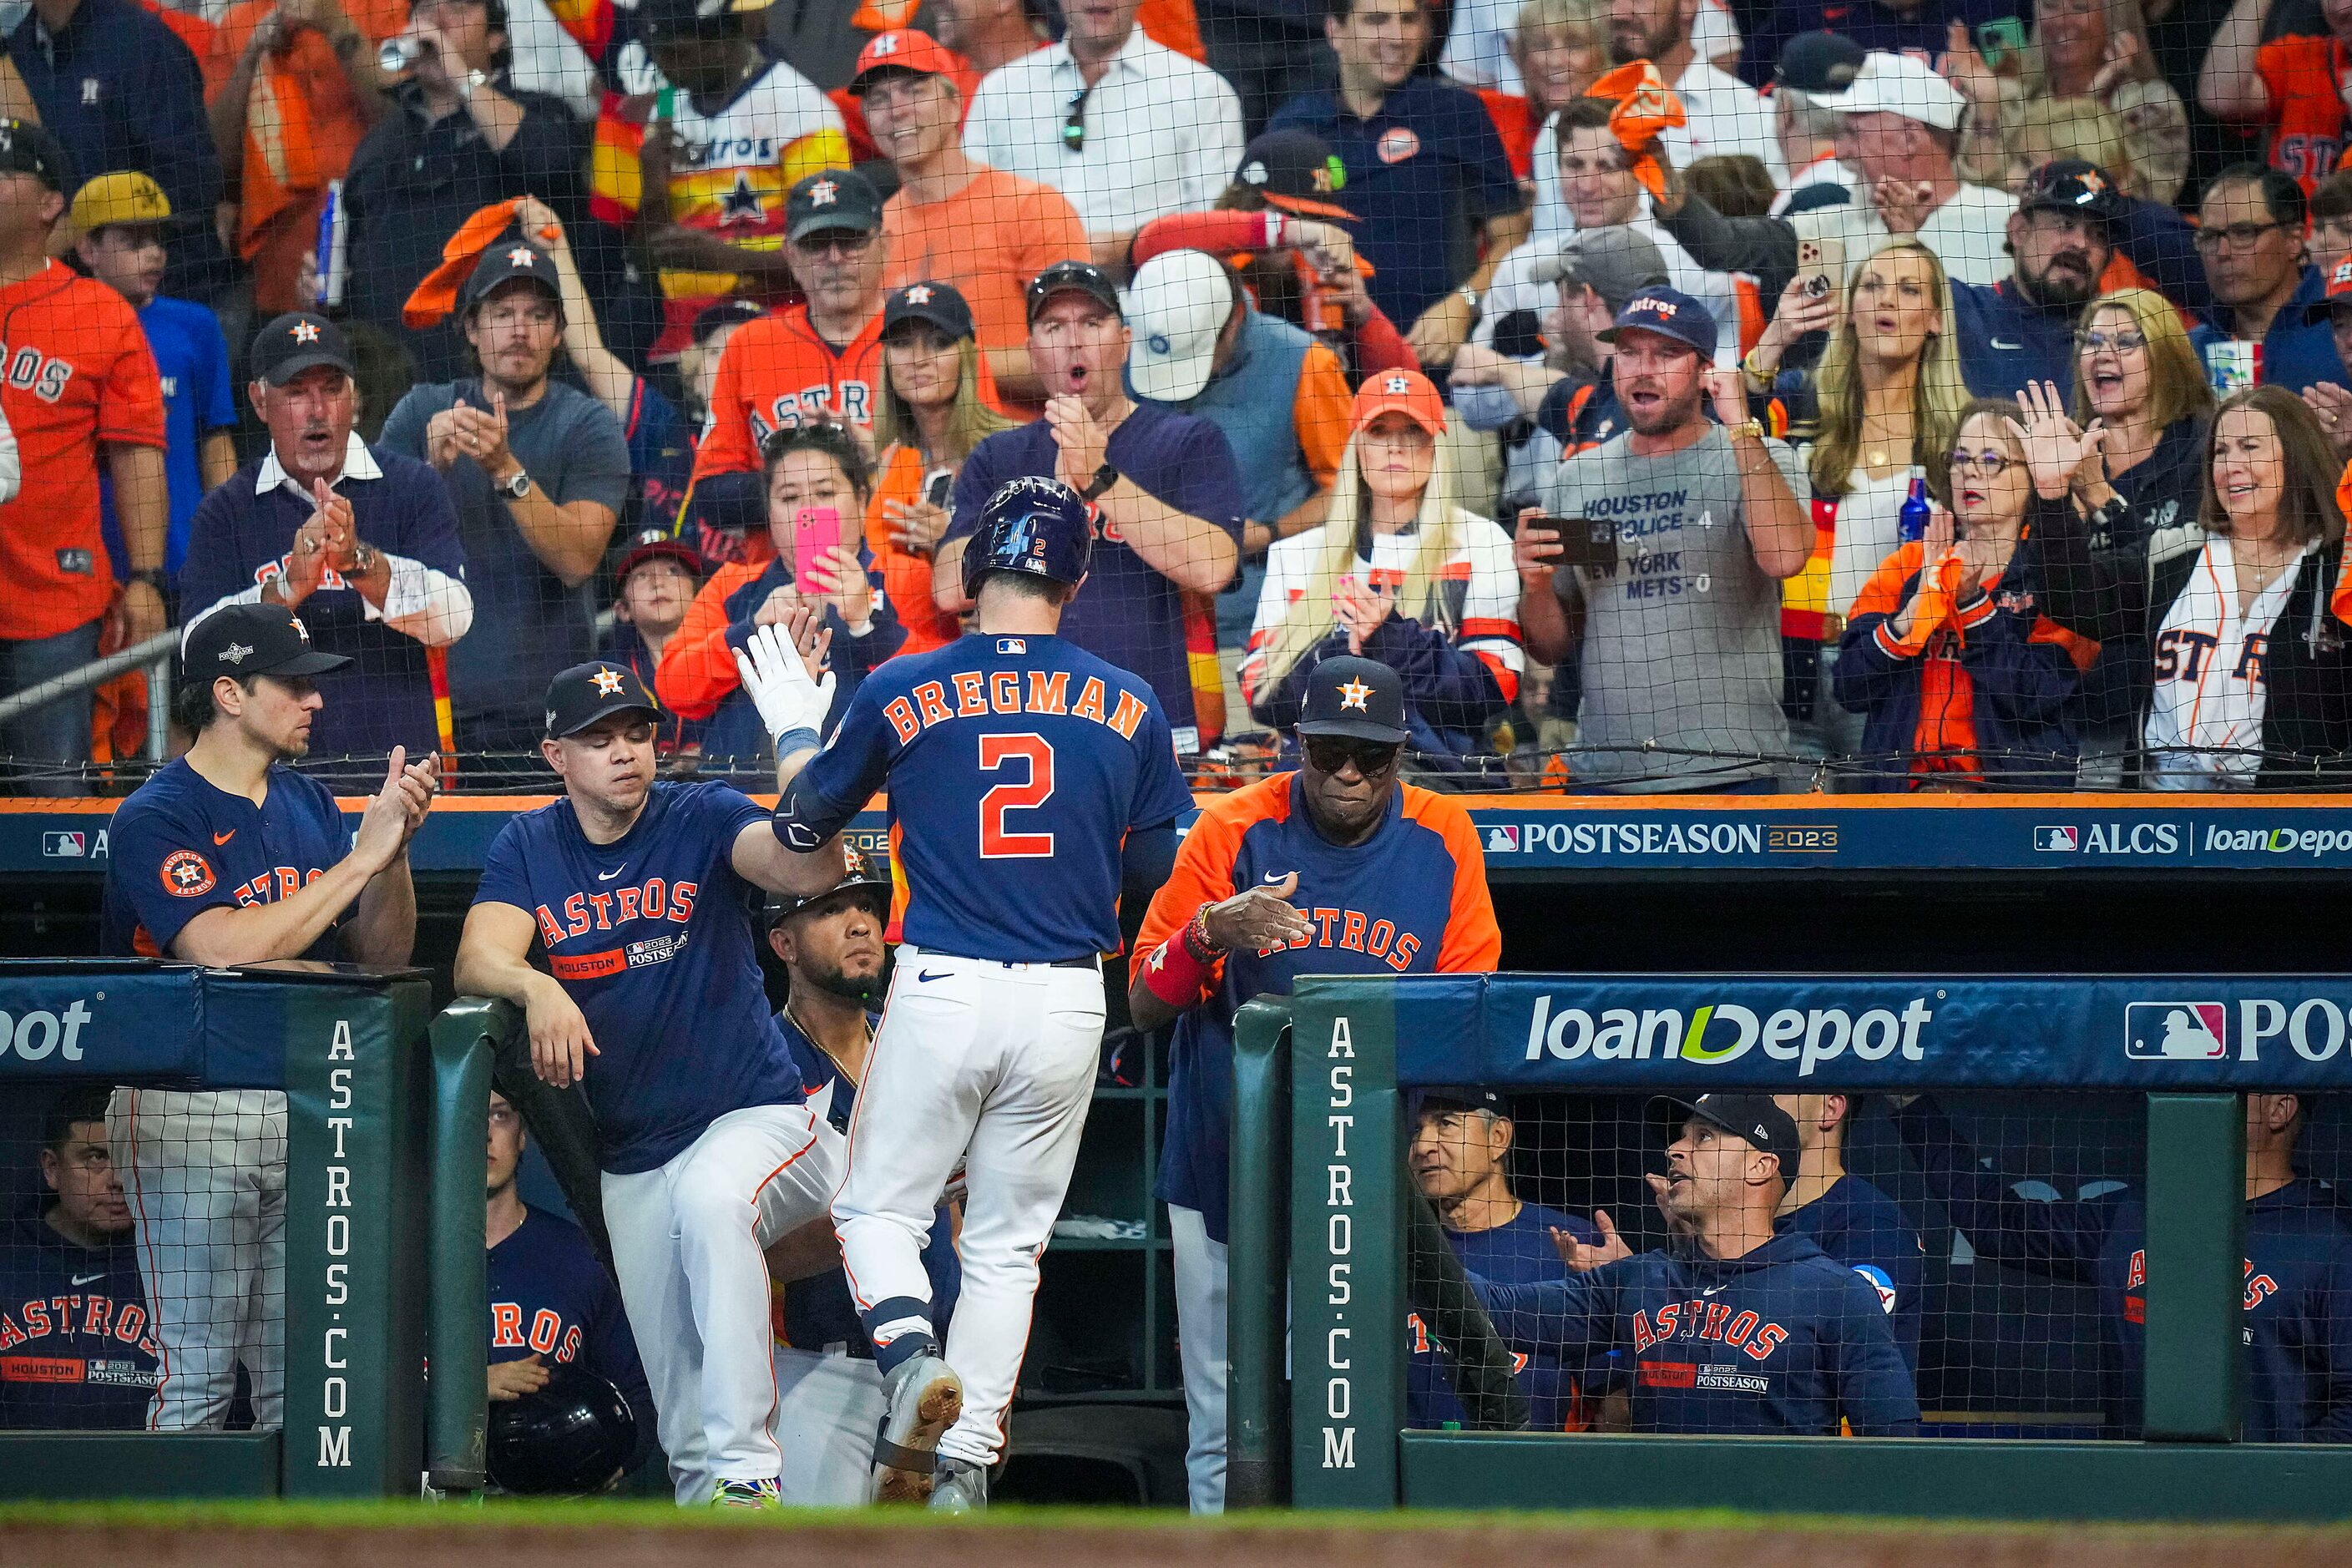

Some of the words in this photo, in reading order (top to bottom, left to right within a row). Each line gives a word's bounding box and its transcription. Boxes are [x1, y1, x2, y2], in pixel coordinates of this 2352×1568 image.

[1626, 296, 1677, 316] Astros
[0, 341, 73, 404] OS
[1583, 489, 1687, 518] HOUSTON
[1033, 538, 1047, 557] 2
[1626, 552, 1682, 575] YORK
[1626, 576, 1683, 600] METS
[593, 670, 624, 695] H
[1340, 682, 1370, 709] H
[883, 670, 1148, 746] BREGMAN
[979, 732, 1055, 859] 2
[1523, 823, 1761, 854] POSTSEASON
[1768, 832, 1838, 847] 2023
[2083, 823, 2178, 854] ALCS
[163, 852, 203, 873] HOUSTON
[175, 879, 212, 894] ASTROS
[534, 877, 698, 949] ASTROS
[644, 937, 673, 948] 2023
[557, 958, 615, 973] HOUSTON
[1526, 995, 1931, 1077] loanDepot
[2239, 997, 2352, 1062] PO
[1633, 1299, 1789, 1361] ASTROS
[11, 1364, 74, 1376] HOUSTON
[1696, 1375, 1769, 1392] POSTSEASON
